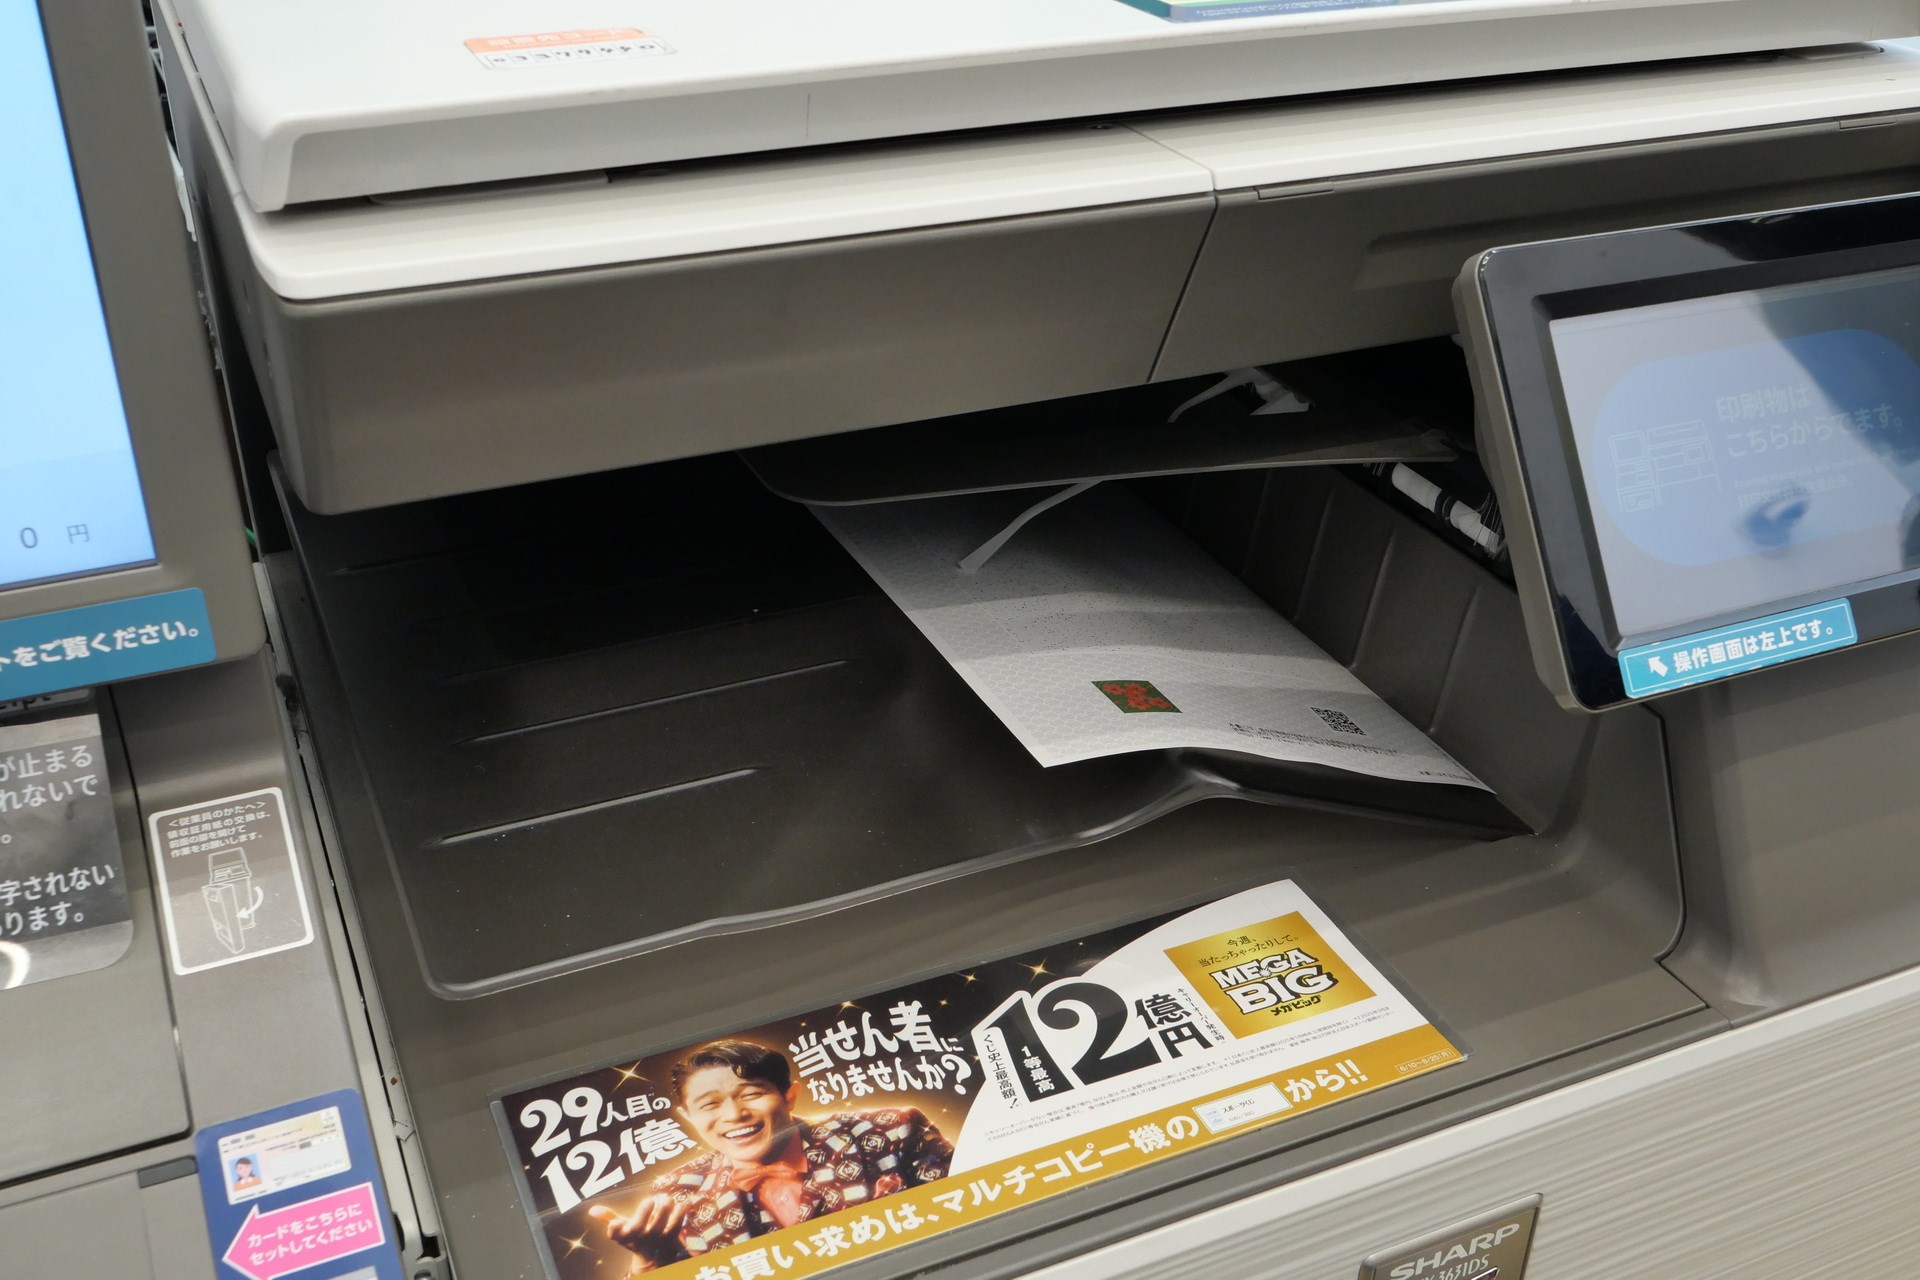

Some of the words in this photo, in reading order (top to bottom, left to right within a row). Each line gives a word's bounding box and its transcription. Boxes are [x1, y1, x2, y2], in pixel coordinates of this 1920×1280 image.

[1717, 384, 1812, 422] 印刷物は
[1727, 403, 1903, 457] こちらからでます。
[20, 527, 38, 548] 0
[67, 523, 90, 544] 円
[1673, 618, 1834, 674] 操作画面は左上です。
[1197, 934, 1300, 968] 当たっちゃったりして。
[1209, 947, 1319, 989] MEGA
[1225, 964, 1339, 1015] BIG
[1270, 994, 1321, 1016] メガビッグ
[789, 1000, 964, 1078] 当せん者に
[1021, 1045, 1055, 1094] 1等最高
[540, 1118, 698, 1214] 12億
[247, 1203, 364, 1249] カードをこちらに
[249, 1219, 374, 1266] セットしてください
[1390, 1223, 1520, 1280] SHARP
